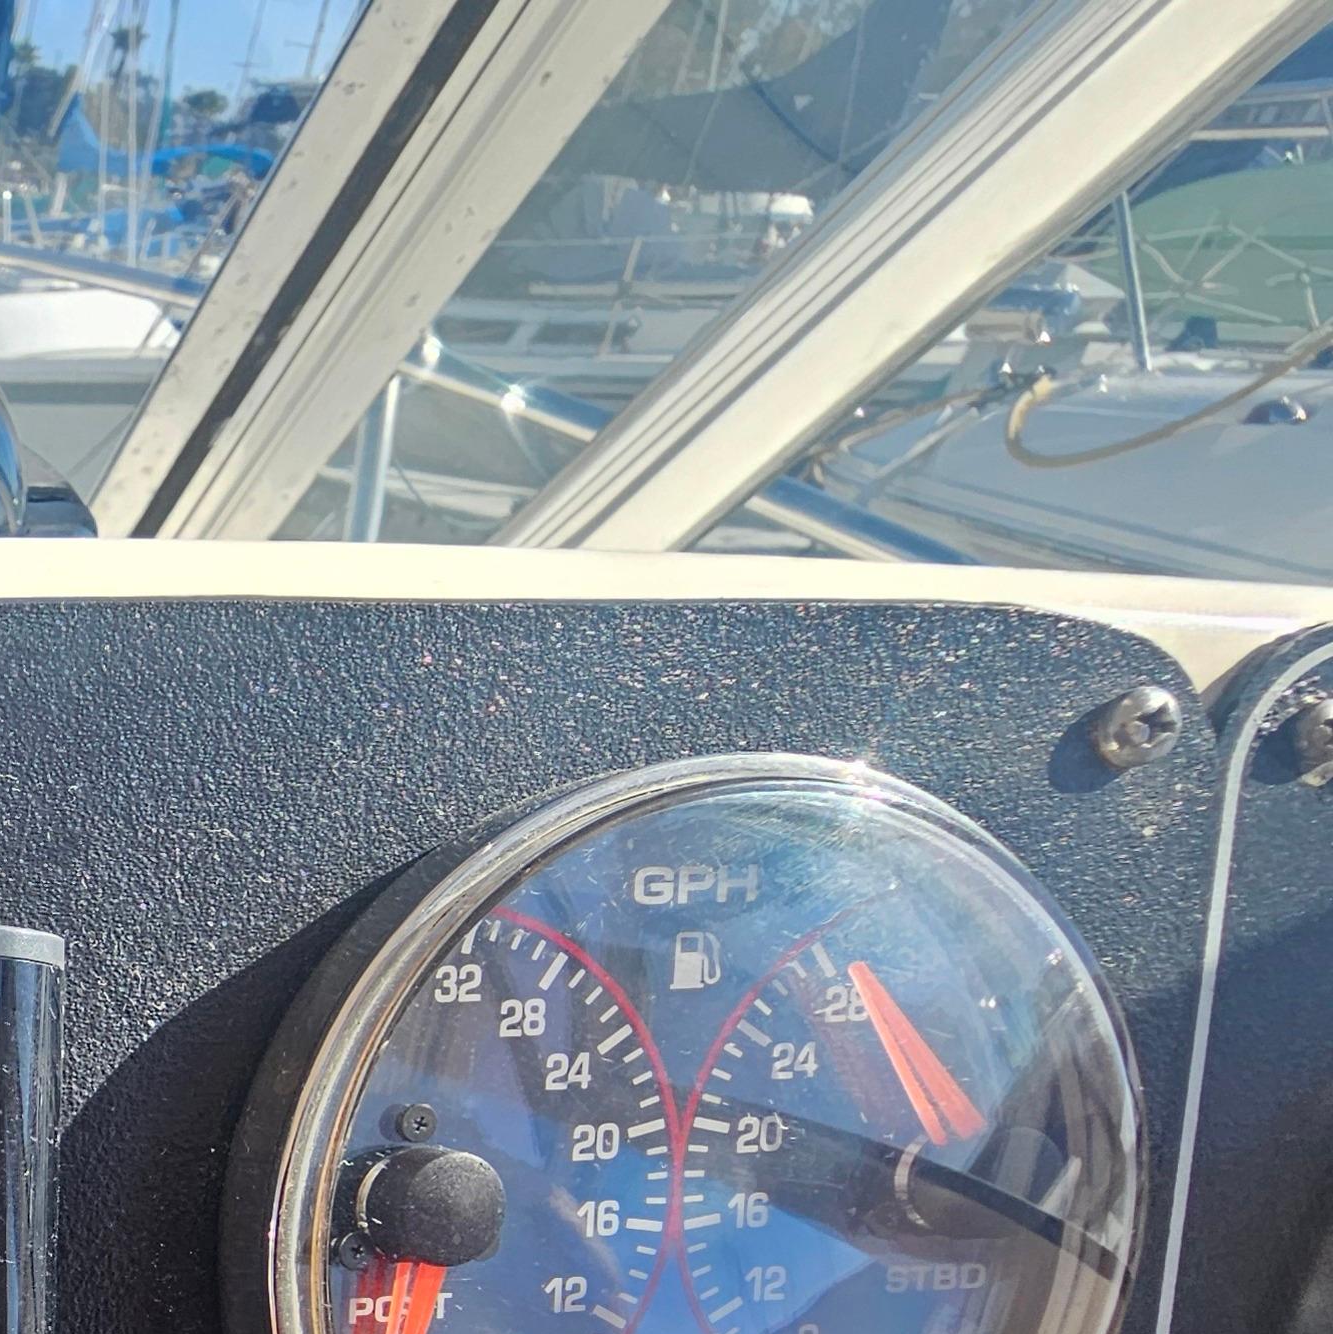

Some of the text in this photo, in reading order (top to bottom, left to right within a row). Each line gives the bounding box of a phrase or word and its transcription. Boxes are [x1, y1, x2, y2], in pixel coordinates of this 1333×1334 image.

[634, 864, 758, 905] GPH
[434, 964, 482, 1003] 32
[499, 998, 546, 1037] 28
[545, 1052, 591, 1091] 24
[772, 1041, 818, 1079] 24
[572, 1122, 620, 1162] 20
[736, 1115, 783, 1154] 20
[577, 1200, 620, 1238] 16
[728, 1192, 769, 1228] 16
[544, 1276, 587, 1314] 12
[745, 1266, 786, 1301] 12
[885, 1262, 987, 1293] STBD
[349, 1293, 453, 1324] POT
